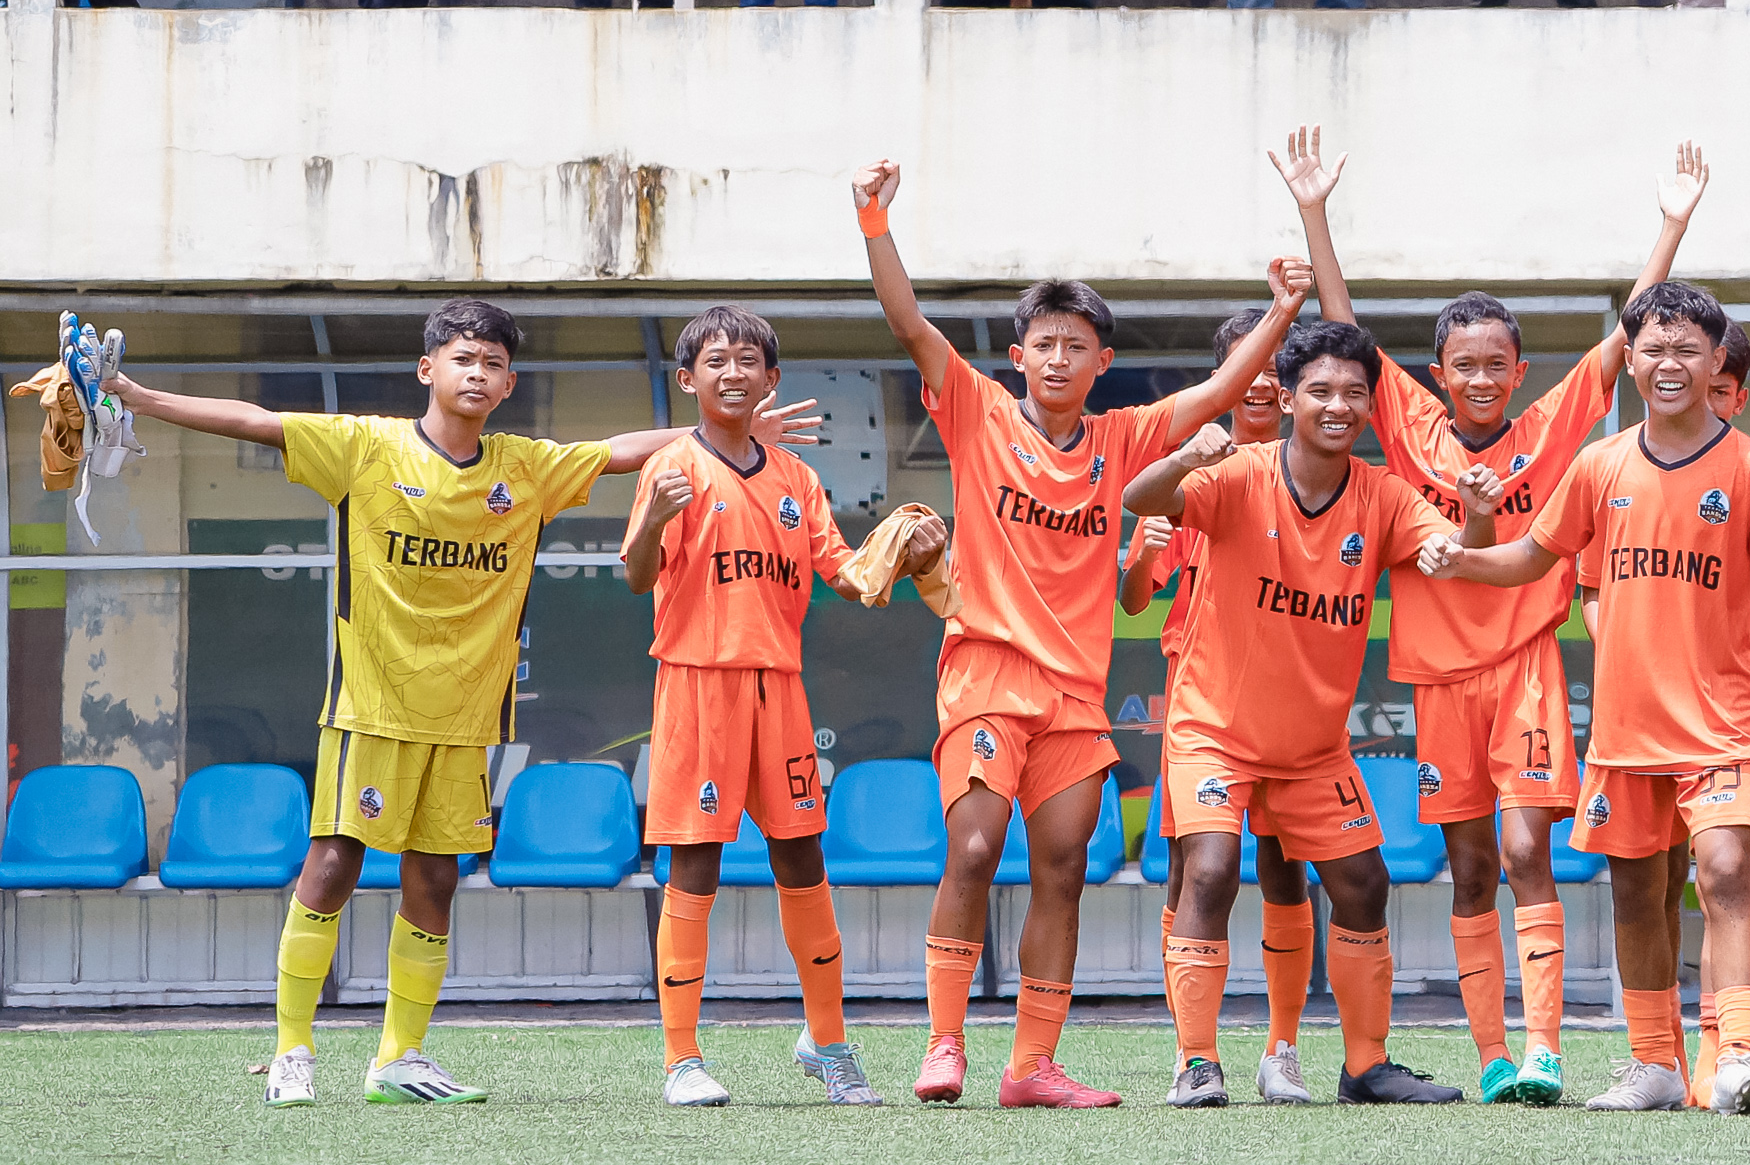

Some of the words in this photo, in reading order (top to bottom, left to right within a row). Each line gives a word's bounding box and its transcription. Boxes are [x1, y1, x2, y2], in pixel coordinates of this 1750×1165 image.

[384, 530, 508, 573] TERBANG
[711, 549, 801, 591] ERBANG
[1610, 547, 1722, 591] TERBANG
[1258, 576, 1365, 627] TEBANG
[1520, 728, 1553, 769] 13
[786, 753, 815, 799] 67
[1335, 776, 1365, 813] 4
